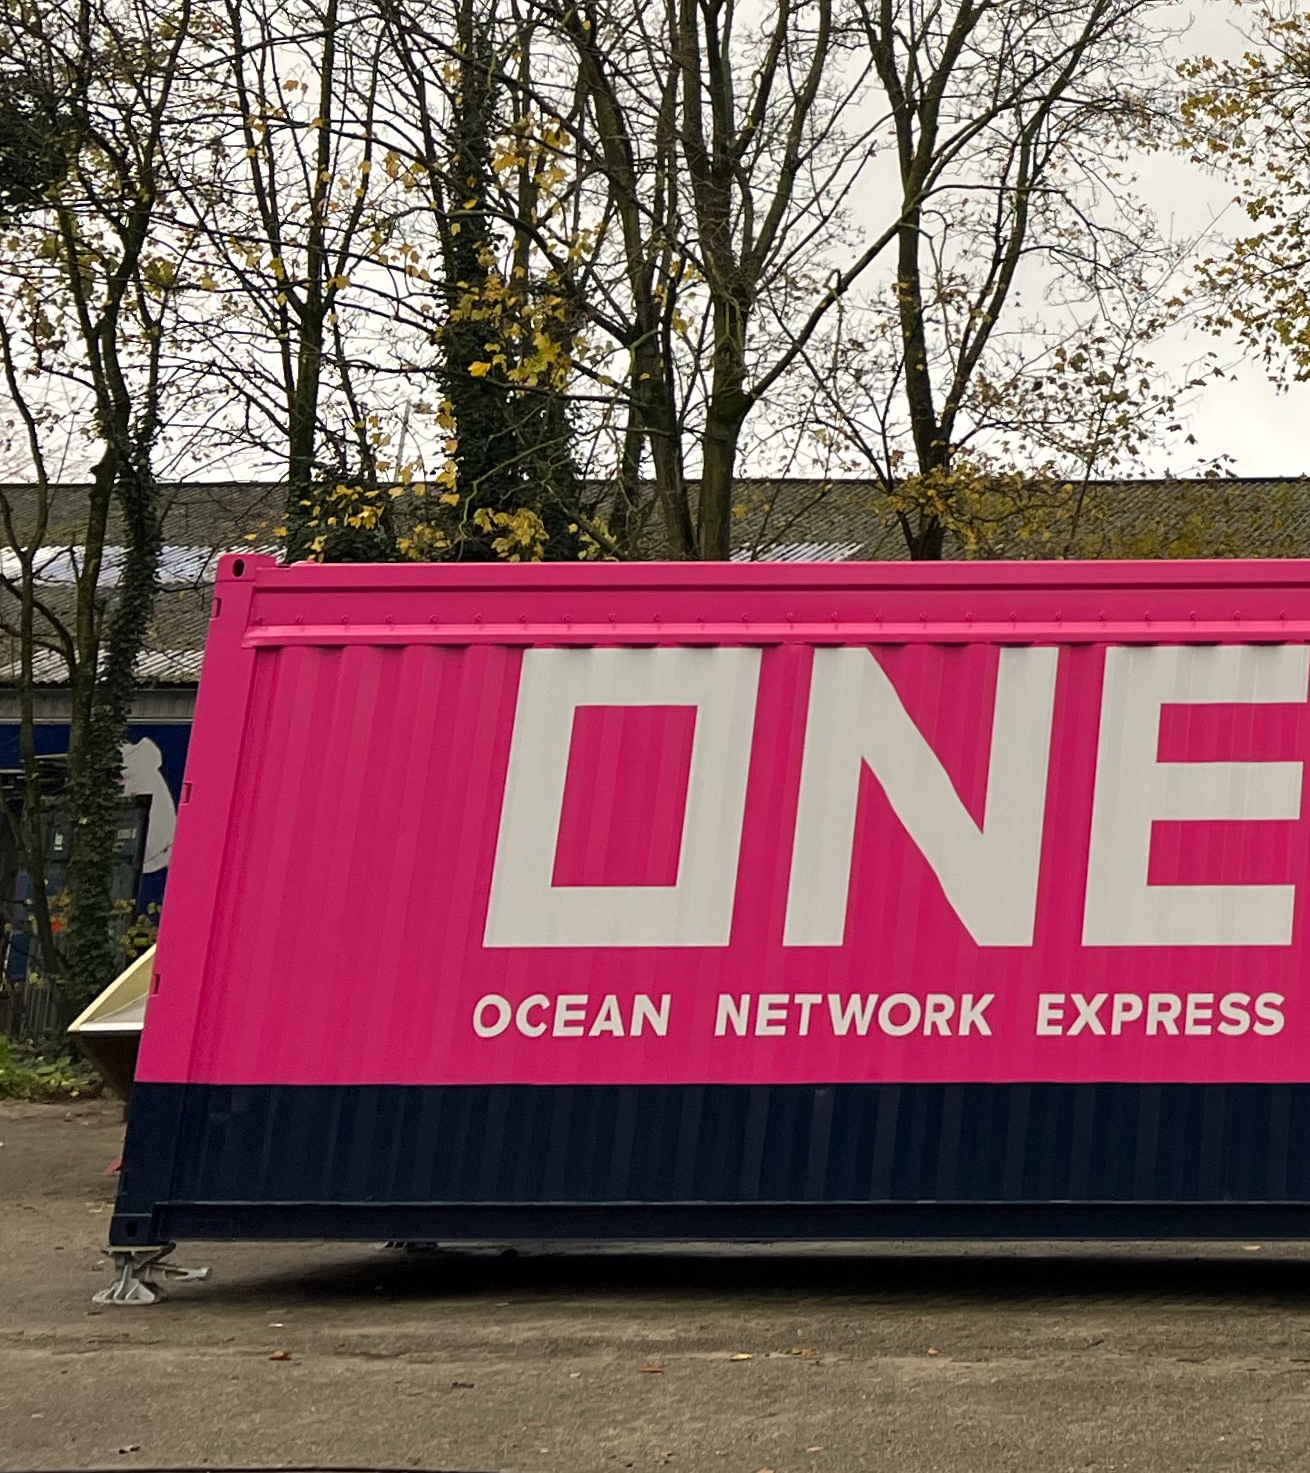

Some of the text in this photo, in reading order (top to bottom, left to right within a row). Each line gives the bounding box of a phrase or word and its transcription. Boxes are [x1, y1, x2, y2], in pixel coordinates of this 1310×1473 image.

[483, 646, 1310, 947] ONE
[472, 990, 1285, 1038] OCEAN NETWORK EXPRESS
